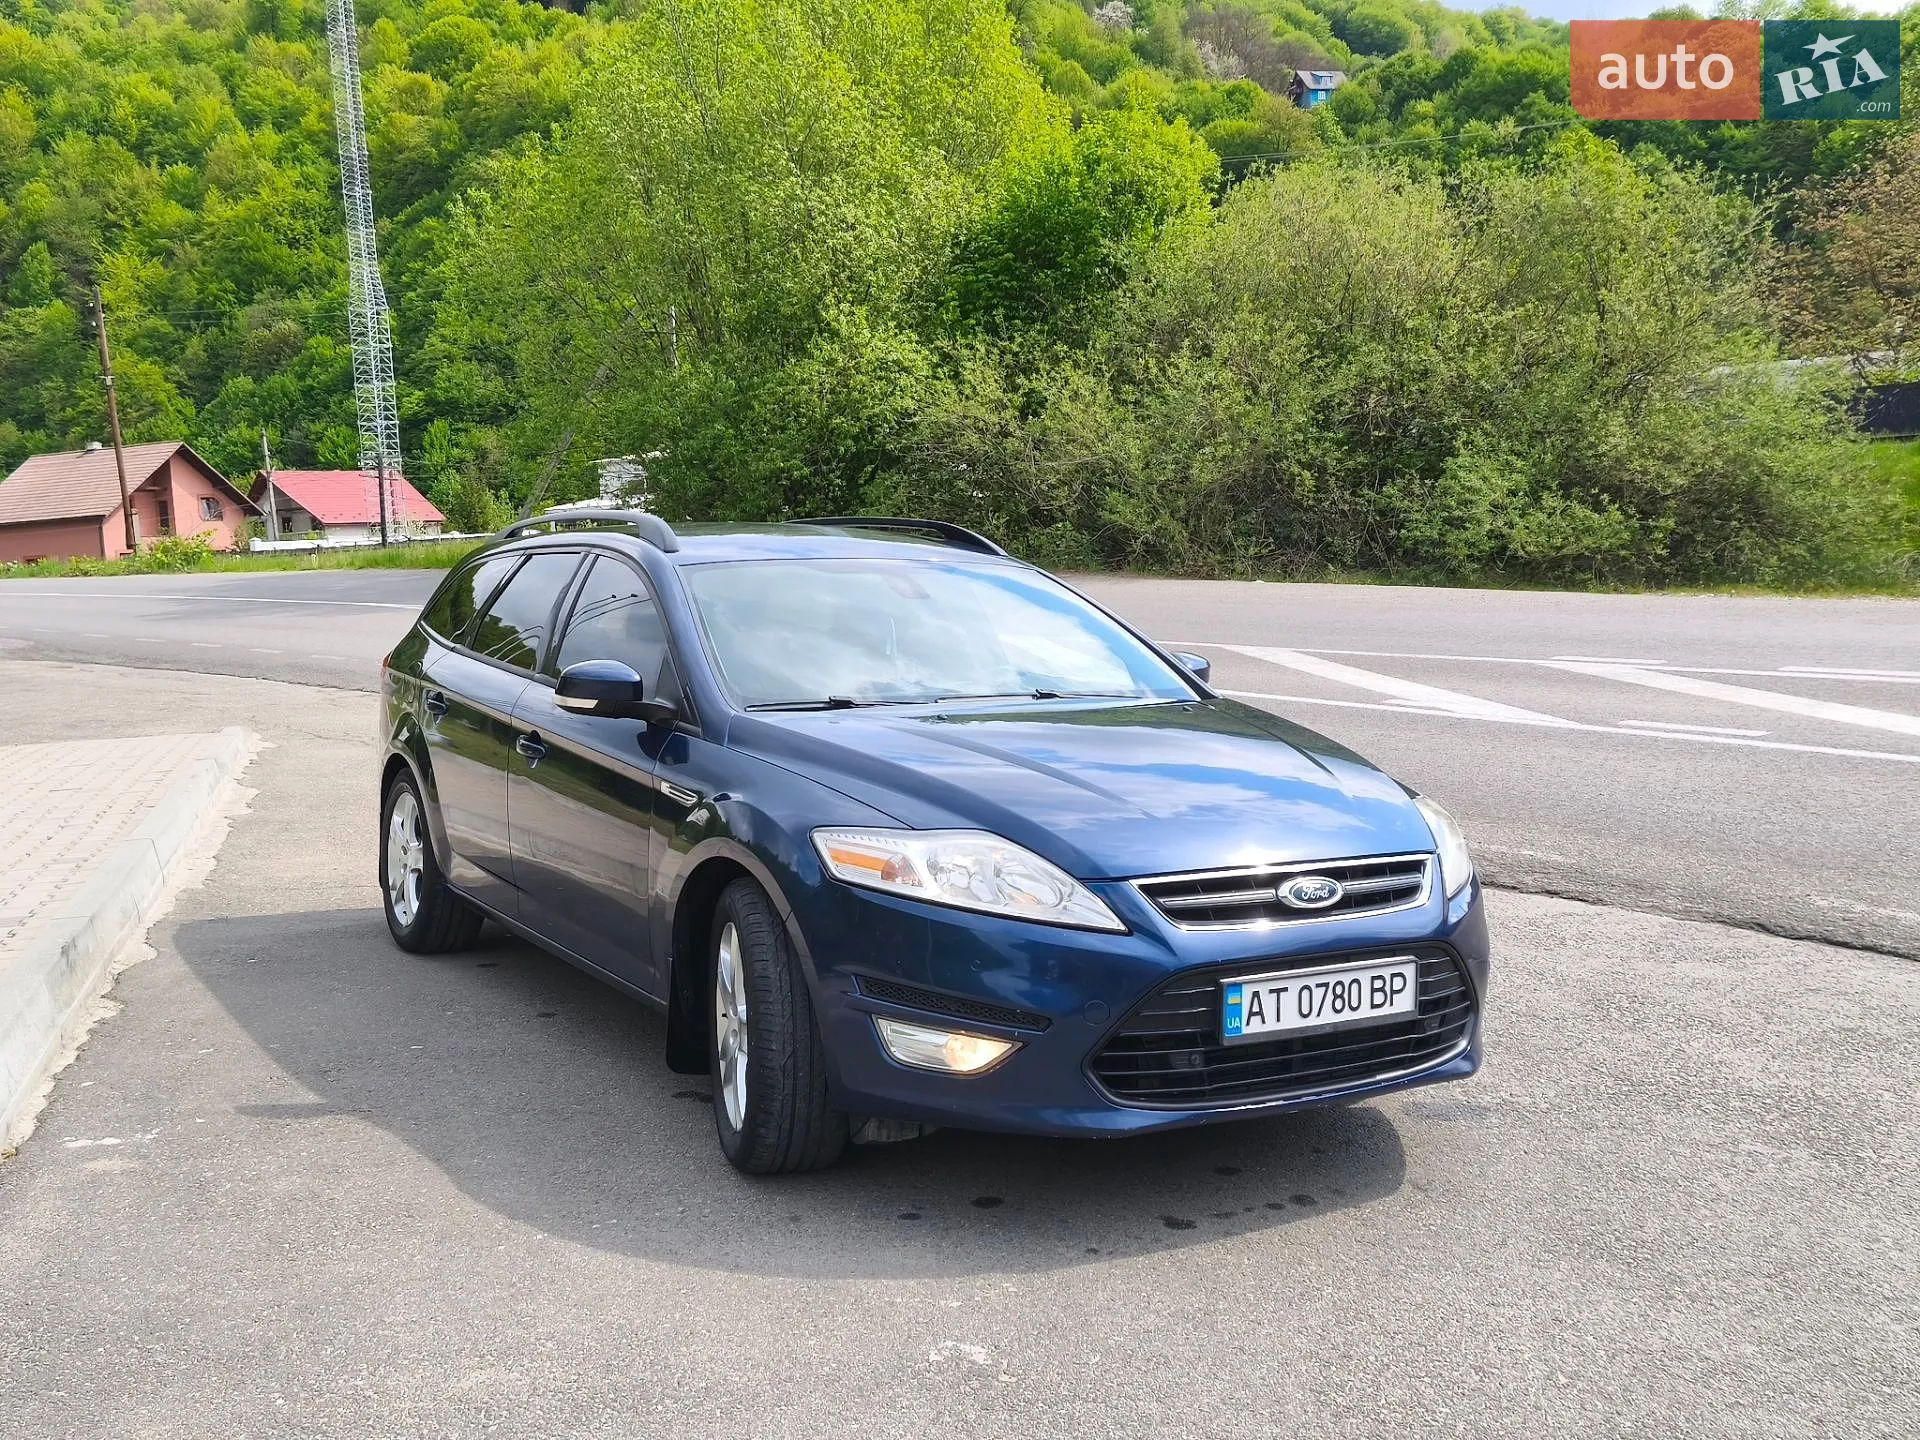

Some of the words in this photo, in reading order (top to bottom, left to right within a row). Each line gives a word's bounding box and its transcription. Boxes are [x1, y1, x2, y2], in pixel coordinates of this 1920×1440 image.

[1302, 883, 1330, 900] Ford
[1246, 986, 1289, 1026] AT
[1298, 977, 1362, 1019] 0780
[1370, 971, 1407, 1010] BP
[1227, 1017, 1241, 1029] UA
